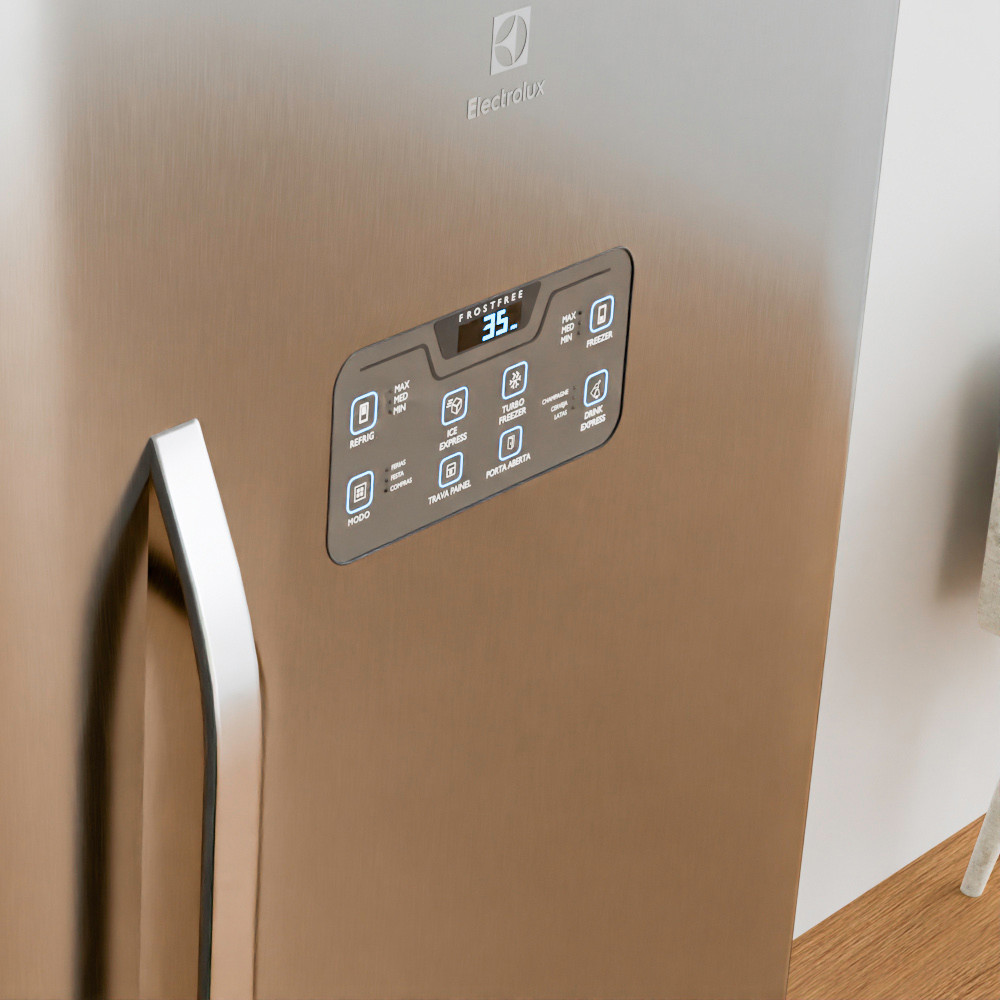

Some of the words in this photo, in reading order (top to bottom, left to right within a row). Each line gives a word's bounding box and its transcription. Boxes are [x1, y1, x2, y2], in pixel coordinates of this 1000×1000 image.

[466, 80, 546, 121] Electrolux
[458, 289, 523, 323] FROSTFREE
[561, 311, 577, 324] MAX
[561, 322, 575, 335] MED
[560, 333, 573, 345] MIN
[586, 330, 613, 348] FREEZER
[394, 379, 410, 393] MAX
[393, 391, 409, 405] MED
[501, 397, 525, 414] TURBO
[392, 402, 407, 415] MIN
[498, 406, 527, 425] FREEZER
[583, 404, 604, 420] DRINK
[580, 413, 606, 432] EXPRESS
[349, 430, 375, 449] REFRIG
[446, 426, 458, 438] ICE
[438, 431, 468, 451] EXPRESS
[485, 463, 507, 479] PORTA
[506, 452, 531, 470] ABERTA
[427, 489, 449, 505] TRAVA
[449, 479, 472, 496] PAINEL
[347, 510, 371, 527] MODO
